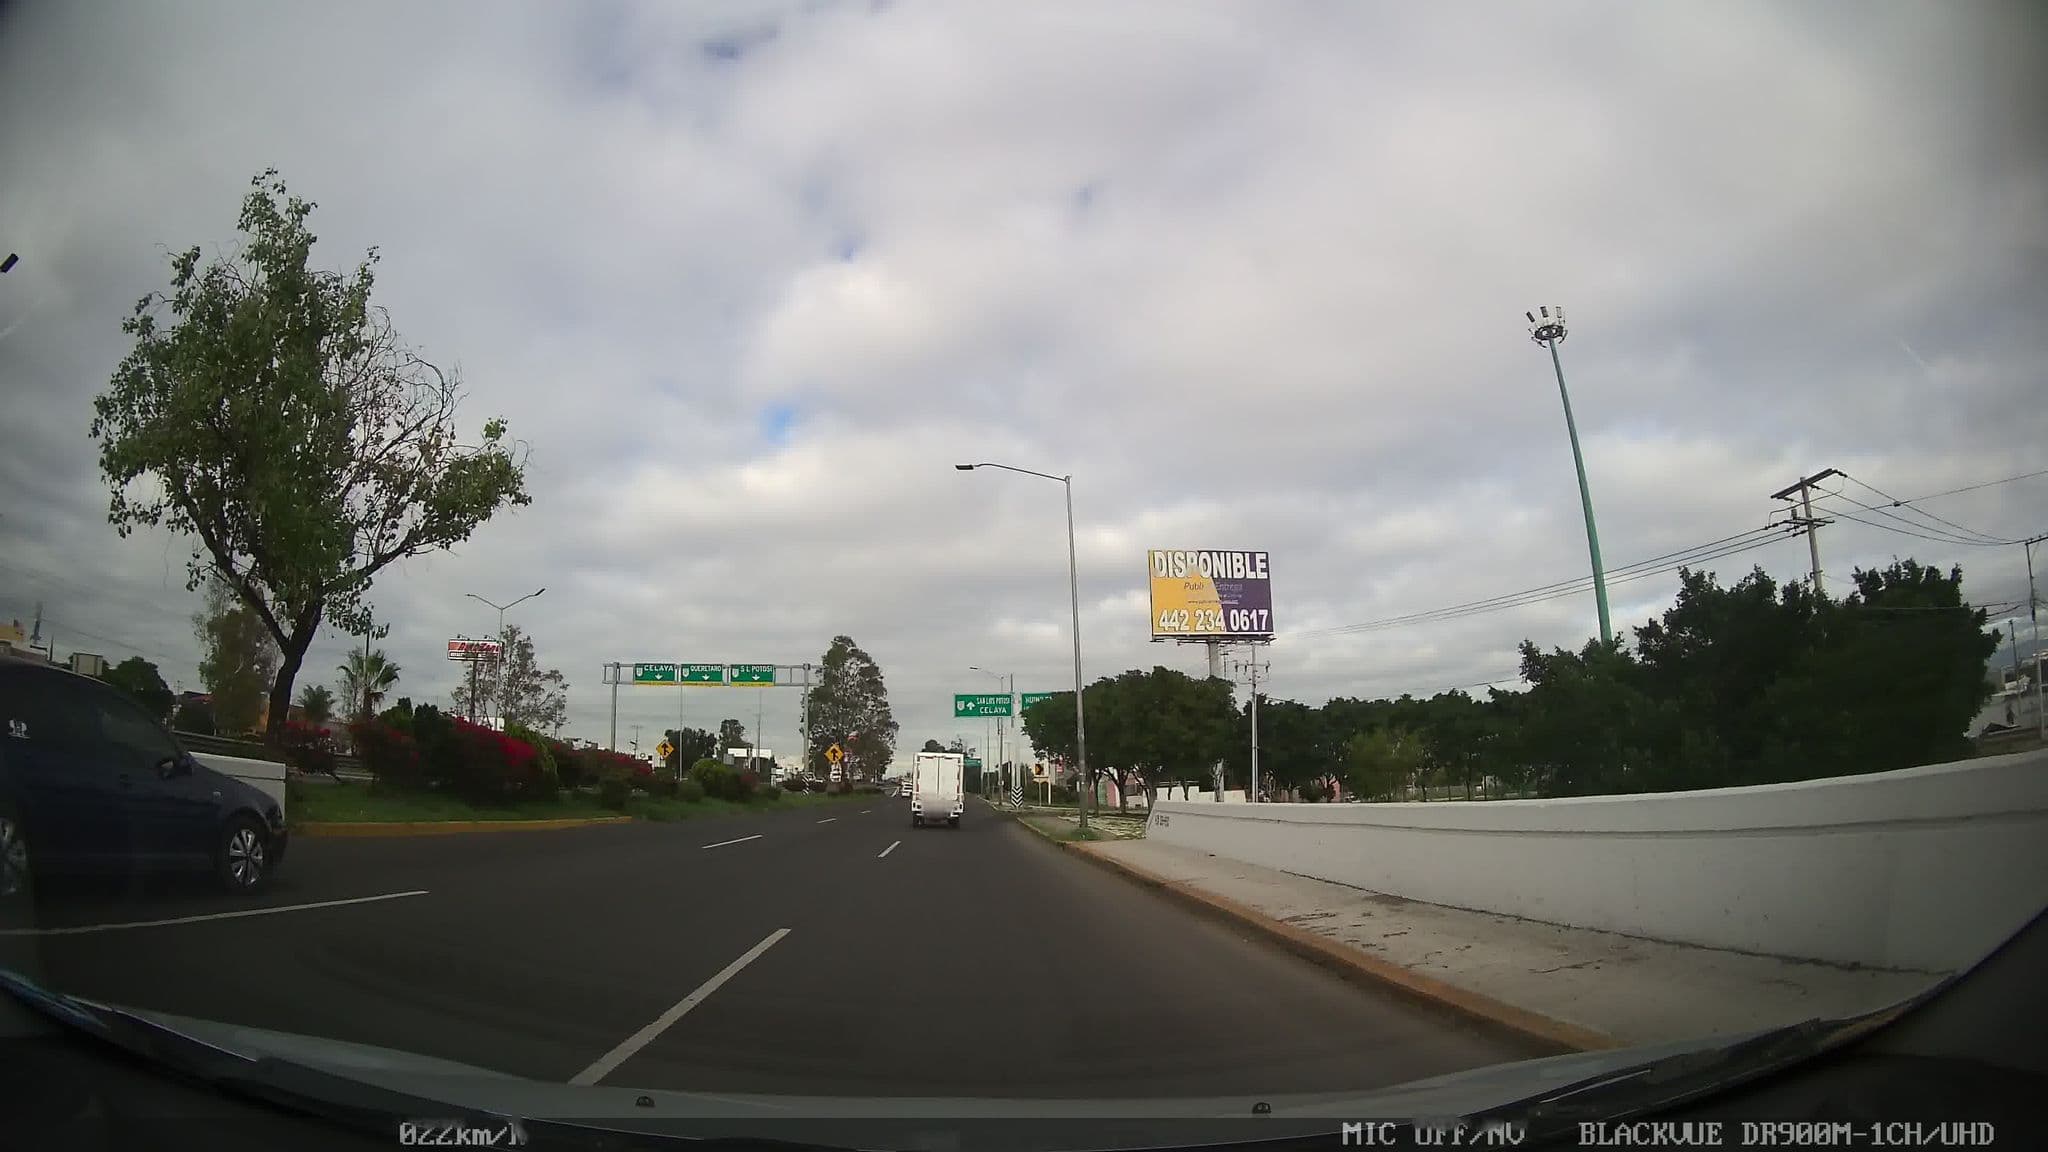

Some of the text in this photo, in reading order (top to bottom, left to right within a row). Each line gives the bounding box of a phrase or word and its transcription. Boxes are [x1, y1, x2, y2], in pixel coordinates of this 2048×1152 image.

[1153, 551, 1268, 579] DISPONIBLE
[1159, 608, 1268, 632] 442 234 0617
[643, 664, 674, 672] CELAYA
[979, 706, 1007, 714] CELAYA
